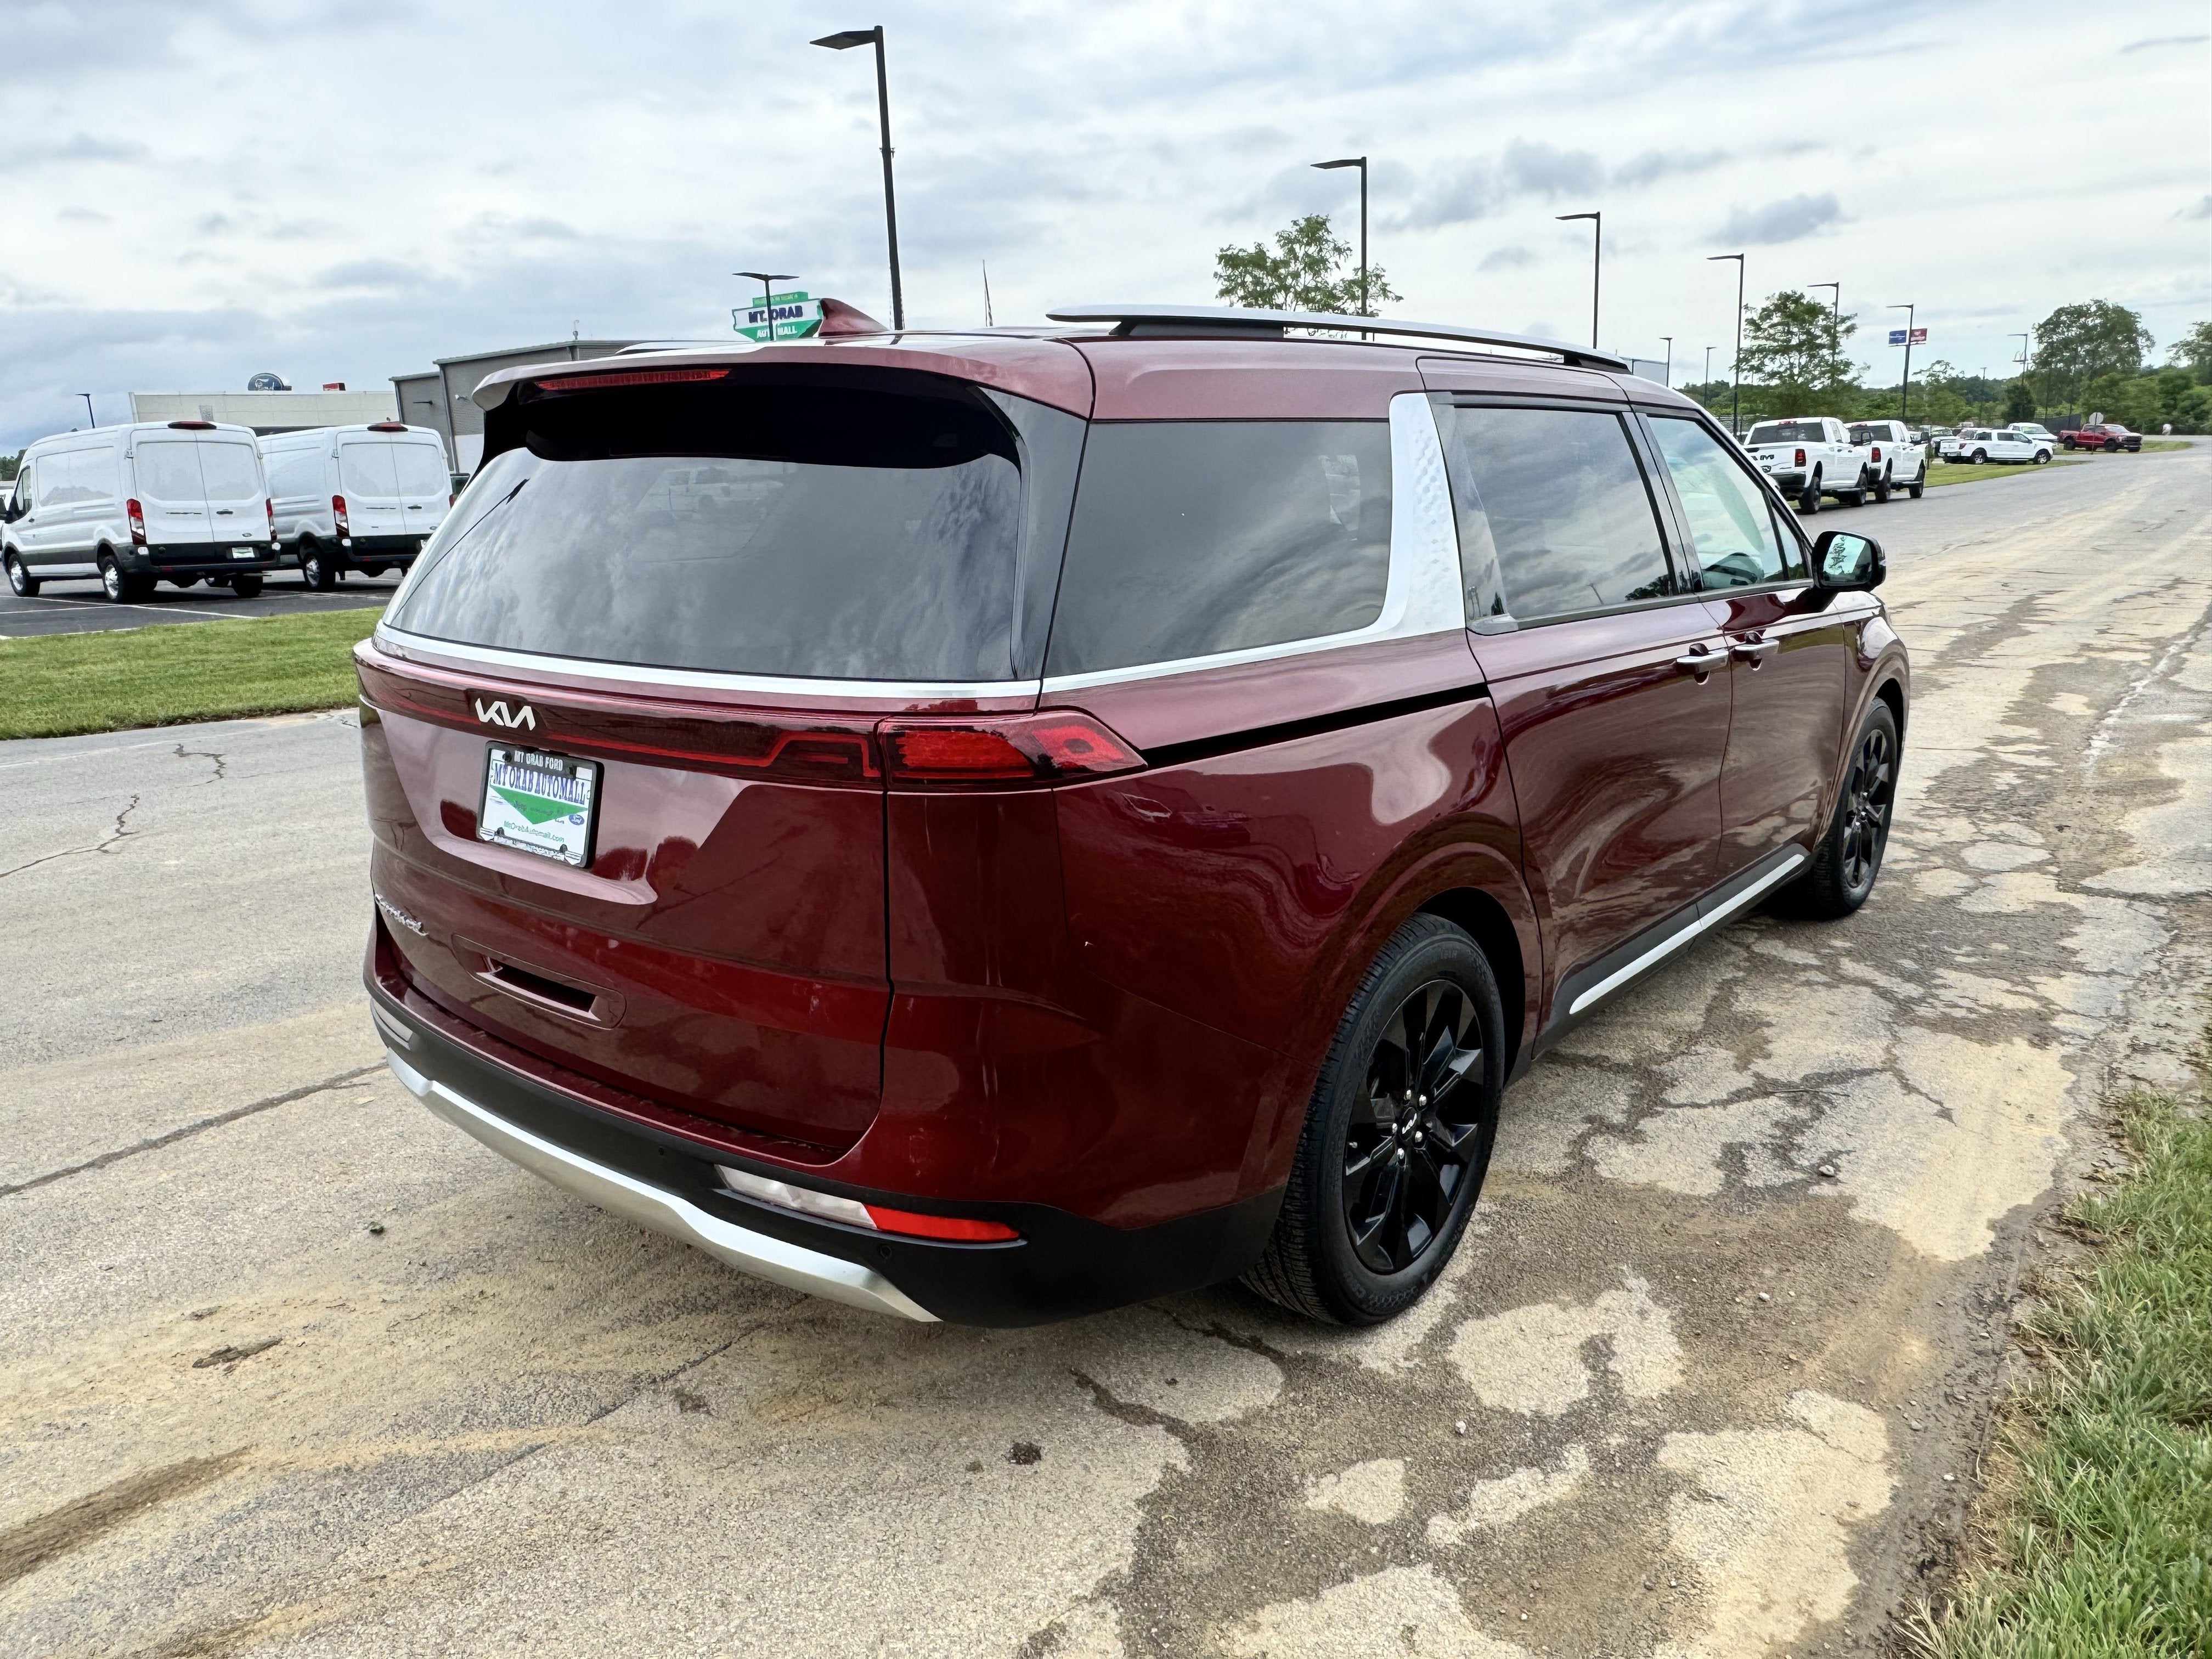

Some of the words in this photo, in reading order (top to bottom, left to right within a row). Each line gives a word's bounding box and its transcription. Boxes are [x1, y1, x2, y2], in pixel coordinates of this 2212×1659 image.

[771, 305, 803, 321] ORAB
[777, 325, 798, 336] MALL
[475, 698, 536, 731] KIA
[514, 750, 524, 763] MT
[545, 757, 563, 771] FORD
[509, 768, 533, 792] ORAB
[534, 771, 585, 805] AUTOMALL
